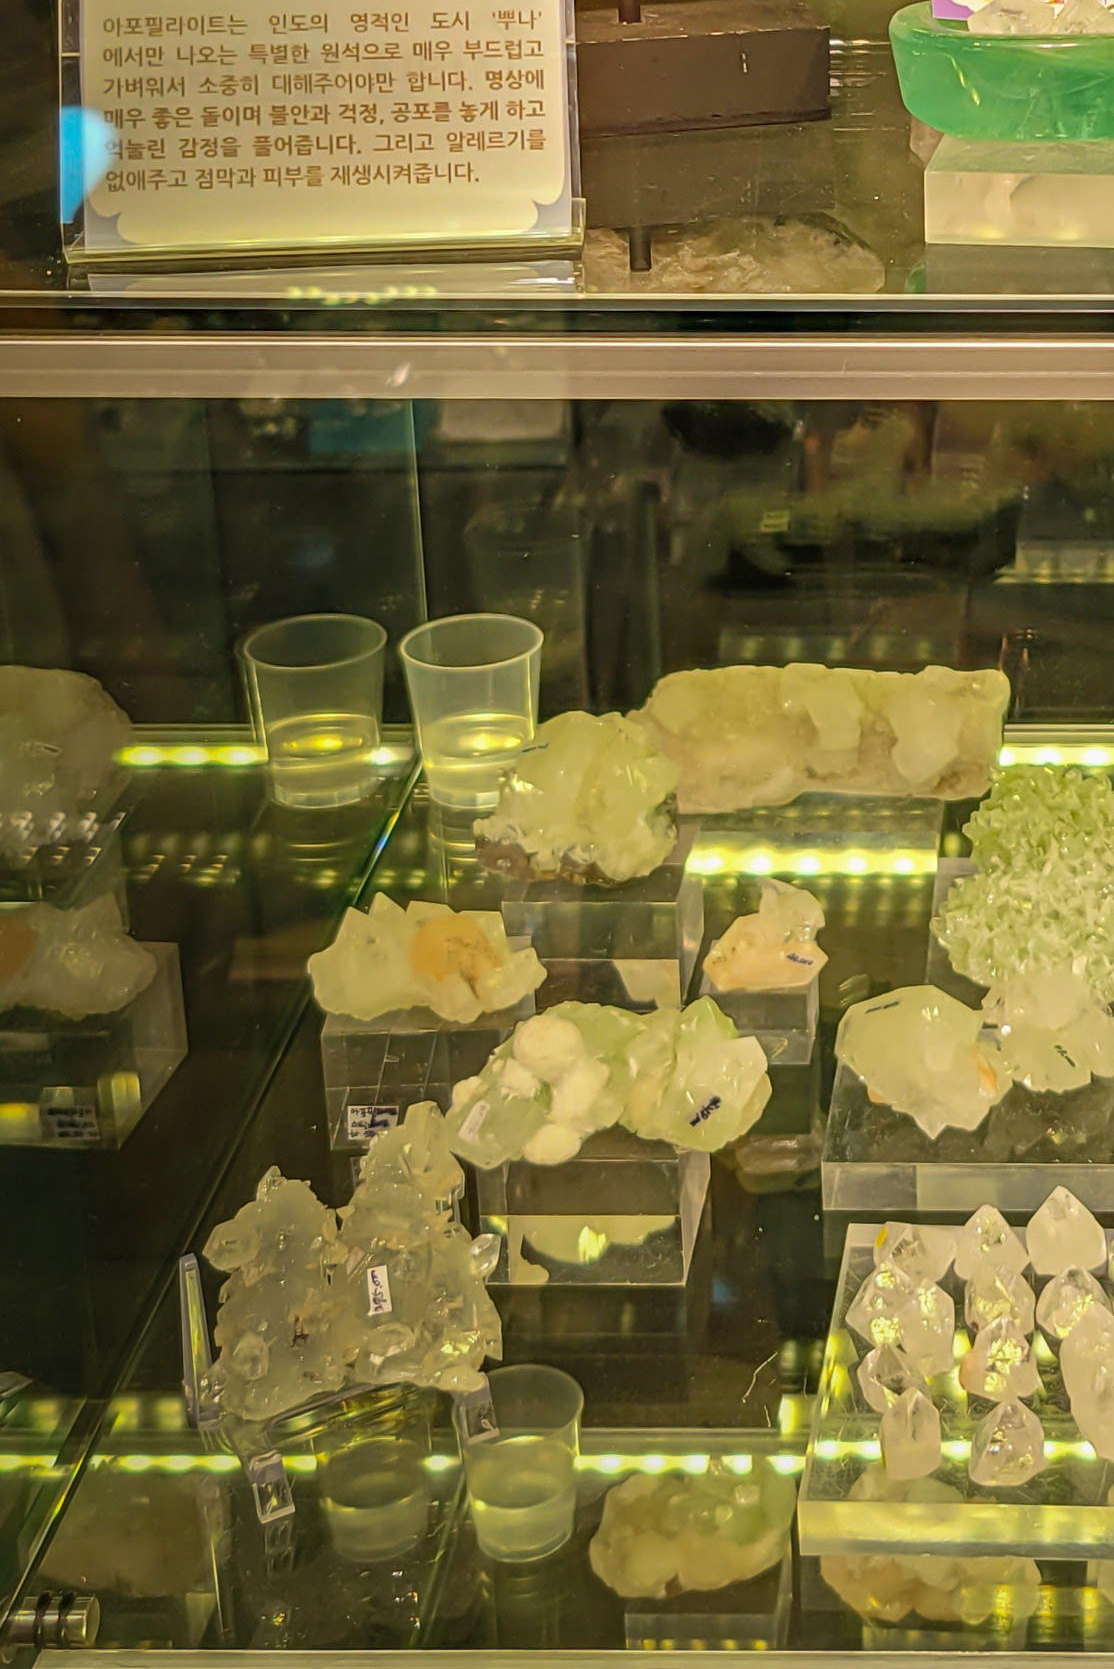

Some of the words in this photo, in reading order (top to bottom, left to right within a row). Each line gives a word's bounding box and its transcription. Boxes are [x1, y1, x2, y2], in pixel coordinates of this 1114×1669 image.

[103, 14, 248, 37] 아포필라이트는
[268, 13, 329, 35] 인도의
[350, 12, 410, 33] 영적인
[430, 11, 470, 32] 도시
[103, 45, 165, 67] 에서만
[177, 44, 238, 66] 나오는
[248, 43, 310, 65] 특별한
[320, 41, 403, 63] 원석으로
[412, 40, 453, 61] 매우
[463, 39, 545, 61] 부드럽고
[103, 76, 186, 98] 가벼워서
[198, 74, 259, 97] 소중히
[272, 72, 395, 95] 대해주어야만
[406, 70, 473, 93] 합니다.
[485, 69, 545, 90] 명상에
[104, 107, 146, 130] 매우
[152, 107, 194, 130] 좋은
[200, 105, 261, 127] 돌이며
[268, 104, 330, 126] 불안과
[338, 103, 385, 126] 걱정,
[391, 101, 452, 123] 공포를
[459, 100, 499, 122] 놓게
[506, 99, 546, 121] 하고
[105, 138, 166, 161] 억눌린
[178, 136, 241, 159] 감정을
[252, 134, 362, 157] 풀어줍니다.
[373, 133, 435, 154] 그리고
[446, 129, 547, 153] 알레르기를
[105, 168, 189, 193] 없애주고
[195, 167, 256, 190] 점막과
[262, 165, 324, 187] 피부를
[330, 162, 480, 186] 재생시켜줍니다.
